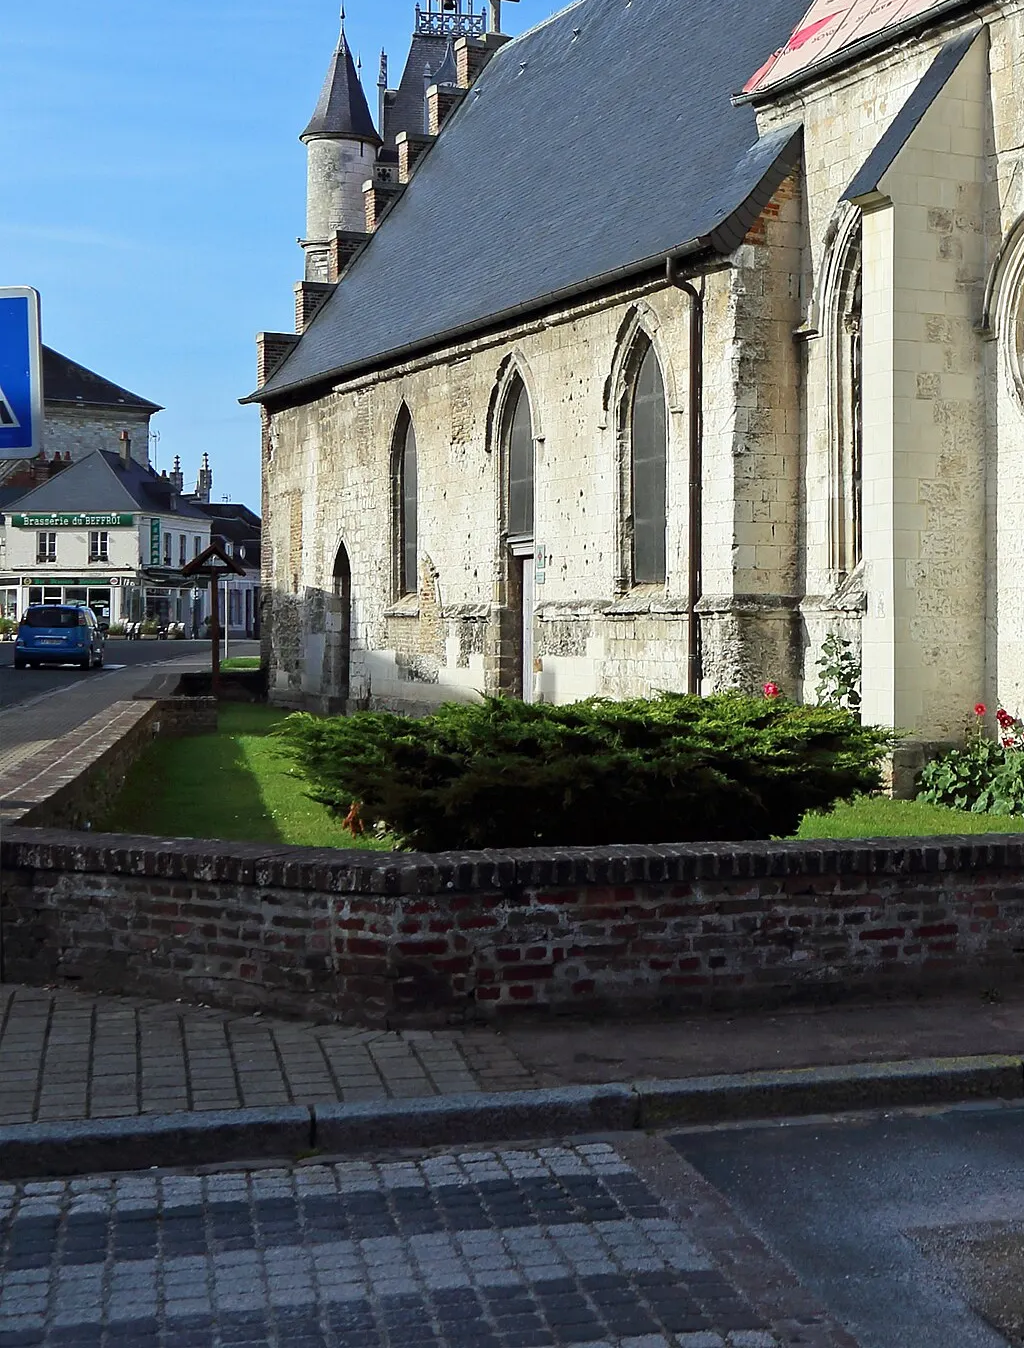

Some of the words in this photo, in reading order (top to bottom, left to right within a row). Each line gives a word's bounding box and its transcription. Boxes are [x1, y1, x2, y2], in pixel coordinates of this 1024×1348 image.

[23, 516, 69, 526] Brasserie
[72, 517, 83, 526] du
[85, 516, 121, 526] BEFFROI
